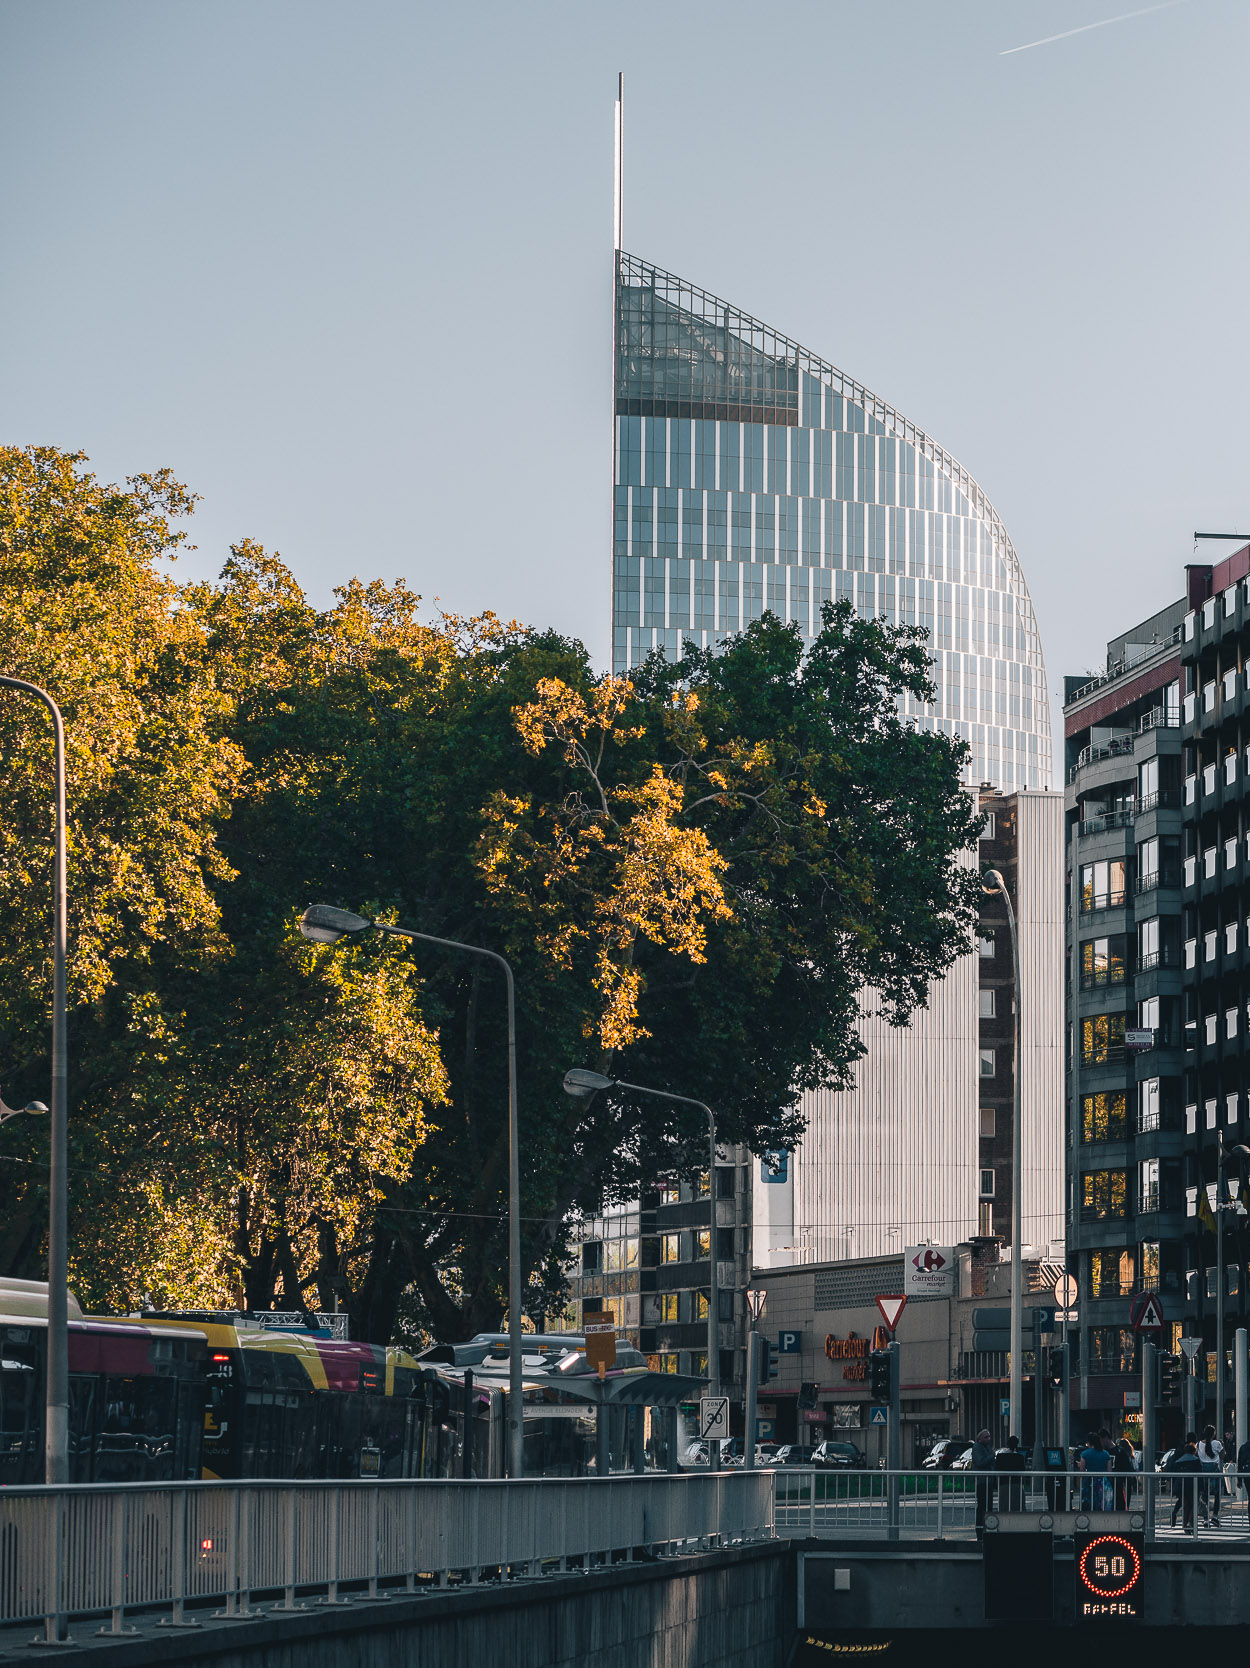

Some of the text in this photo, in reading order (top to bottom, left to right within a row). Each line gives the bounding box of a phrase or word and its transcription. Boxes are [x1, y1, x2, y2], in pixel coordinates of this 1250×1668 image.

[911, 1274, 946, 1282] Carrefour
[783, 1333, 796, 1351] P
[824, 1331, 868, 1359] Carrefour
[1001, 1401, 1010, 1413] P
[706, 1412, 723, 1425] 30
[758, 1421, 772, 1437] P
[1095, 1556, 1125, 1576] 50
